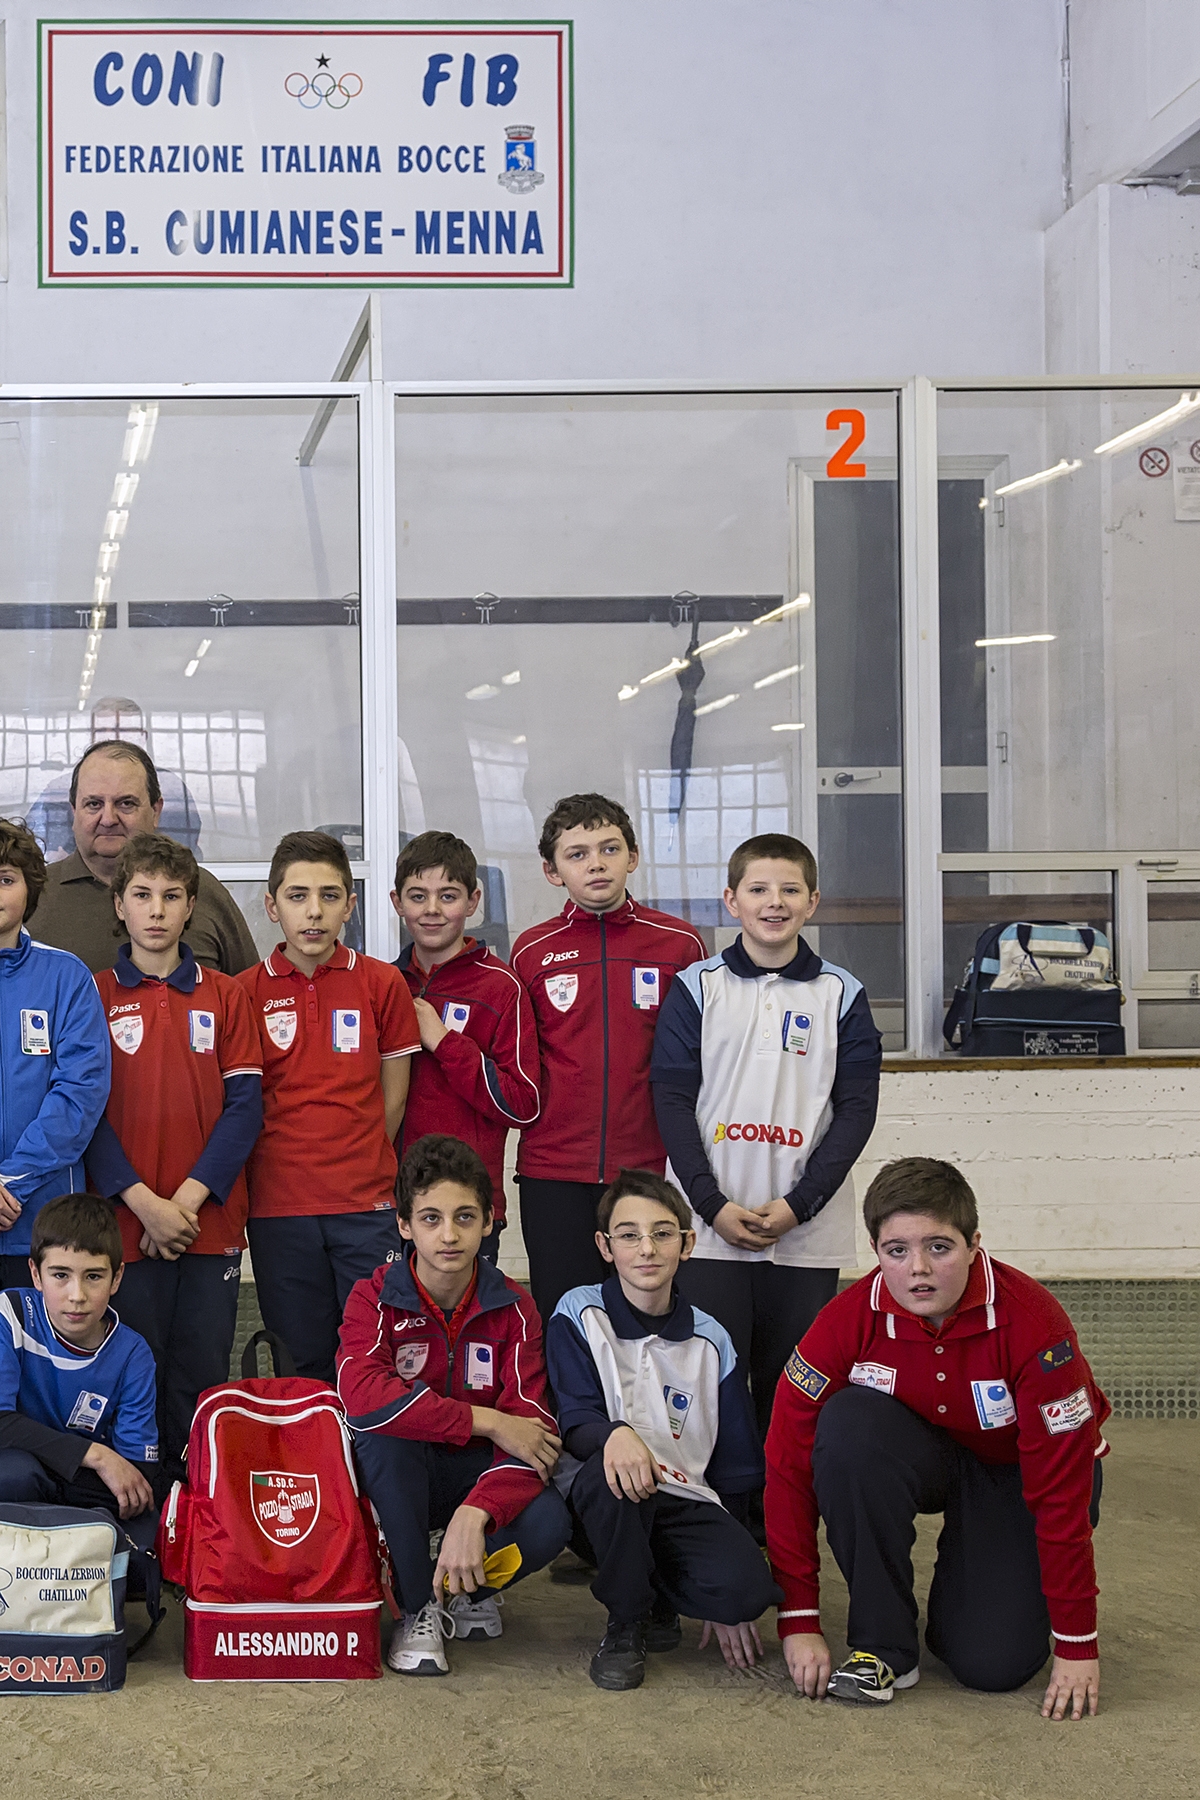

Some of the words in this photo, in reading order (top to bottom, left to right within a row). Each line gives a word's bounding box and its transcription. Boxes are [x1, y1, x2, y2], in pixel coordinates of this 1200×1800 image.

[93, 50, 225, 107] CONI
[422, 52, 519, 108] FIB
[64, 144, 244, 174] FEDERAZIONE
[261, 144, 382, 174] ITALIANA
[398, 144, 486, 174] BOCCE
[68, 209, 139, 256] S.B.
[165, 209, 545, 256] CUMIANESE-MENNA
[826, 409, 866, 478] 2
[726, 1123, 804, 1148] CONAD
[259, 1502, 278, 1521] POZZO
[290, 1490, 315, 1512] STRADA
[274, 1527, 300, 1538] TORINO
[16, 1567, 69, 1580] BOCCIOFILA
[71, 1567, 106, 1580] ZERBION
[39, 1589, 87, 1601] CHATILLON
[215, 1632, 339, 1656] ALESSANDRO
[347, 1632, 358, 1656] P.
